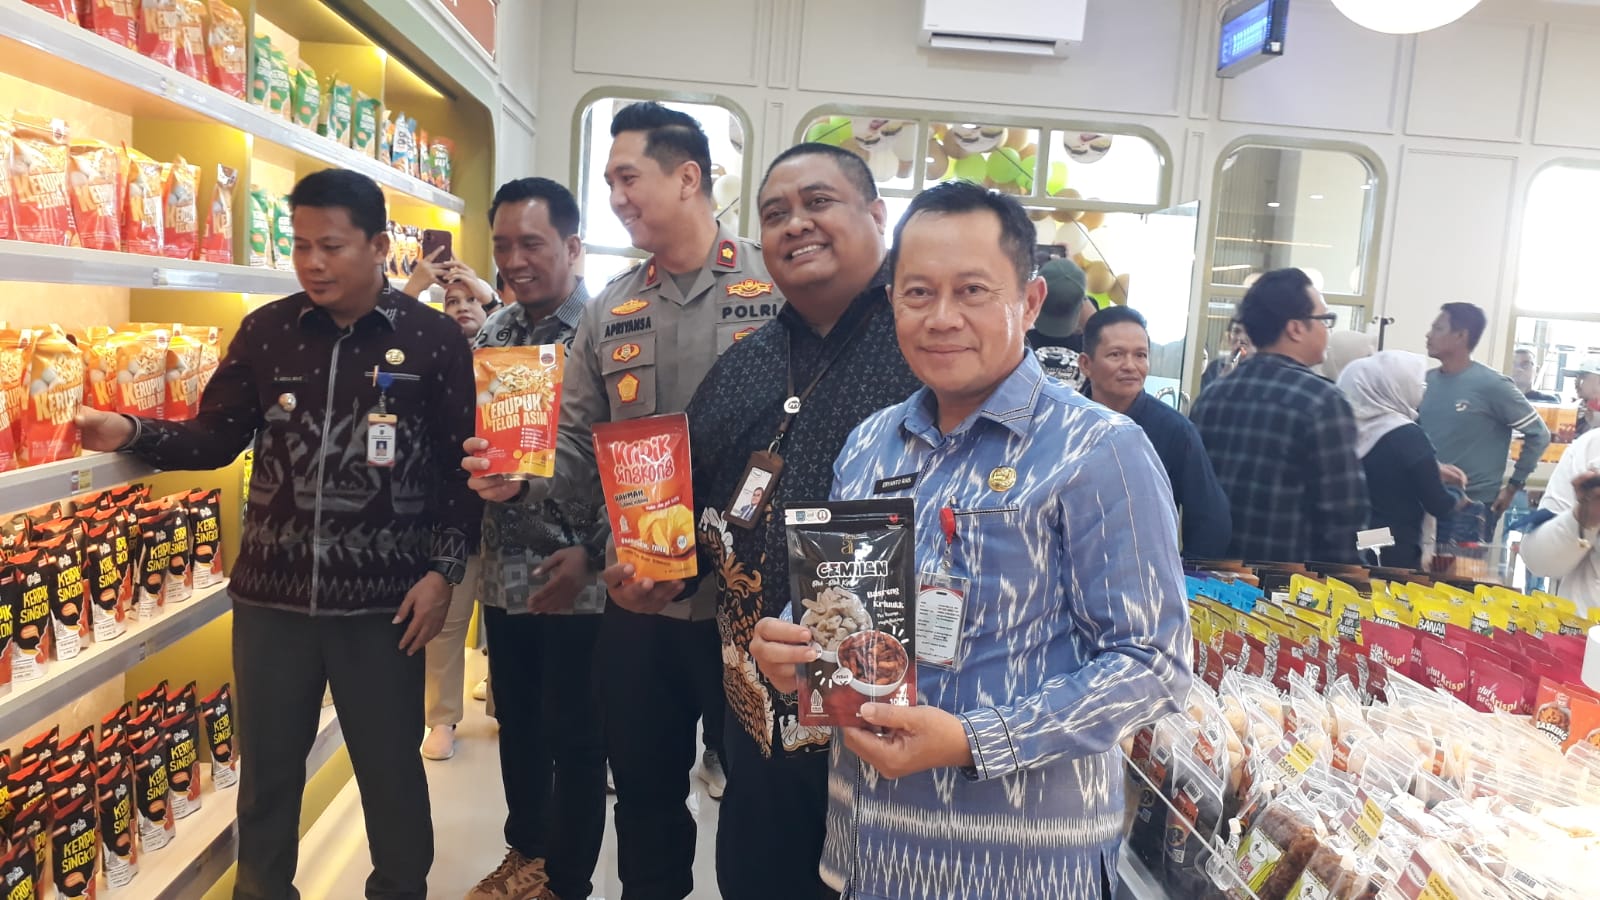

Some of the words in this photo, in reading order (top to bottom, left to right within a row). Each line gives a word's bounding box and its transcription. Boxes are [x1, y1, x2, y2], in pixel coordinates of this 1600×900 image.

[722, 303, 777, 319] POLRI
[605, 316, 651, 338] APRIYANSA
[481, 393, 542, 431] KERUPUK
[492, 412, 521, 433] TELOR
